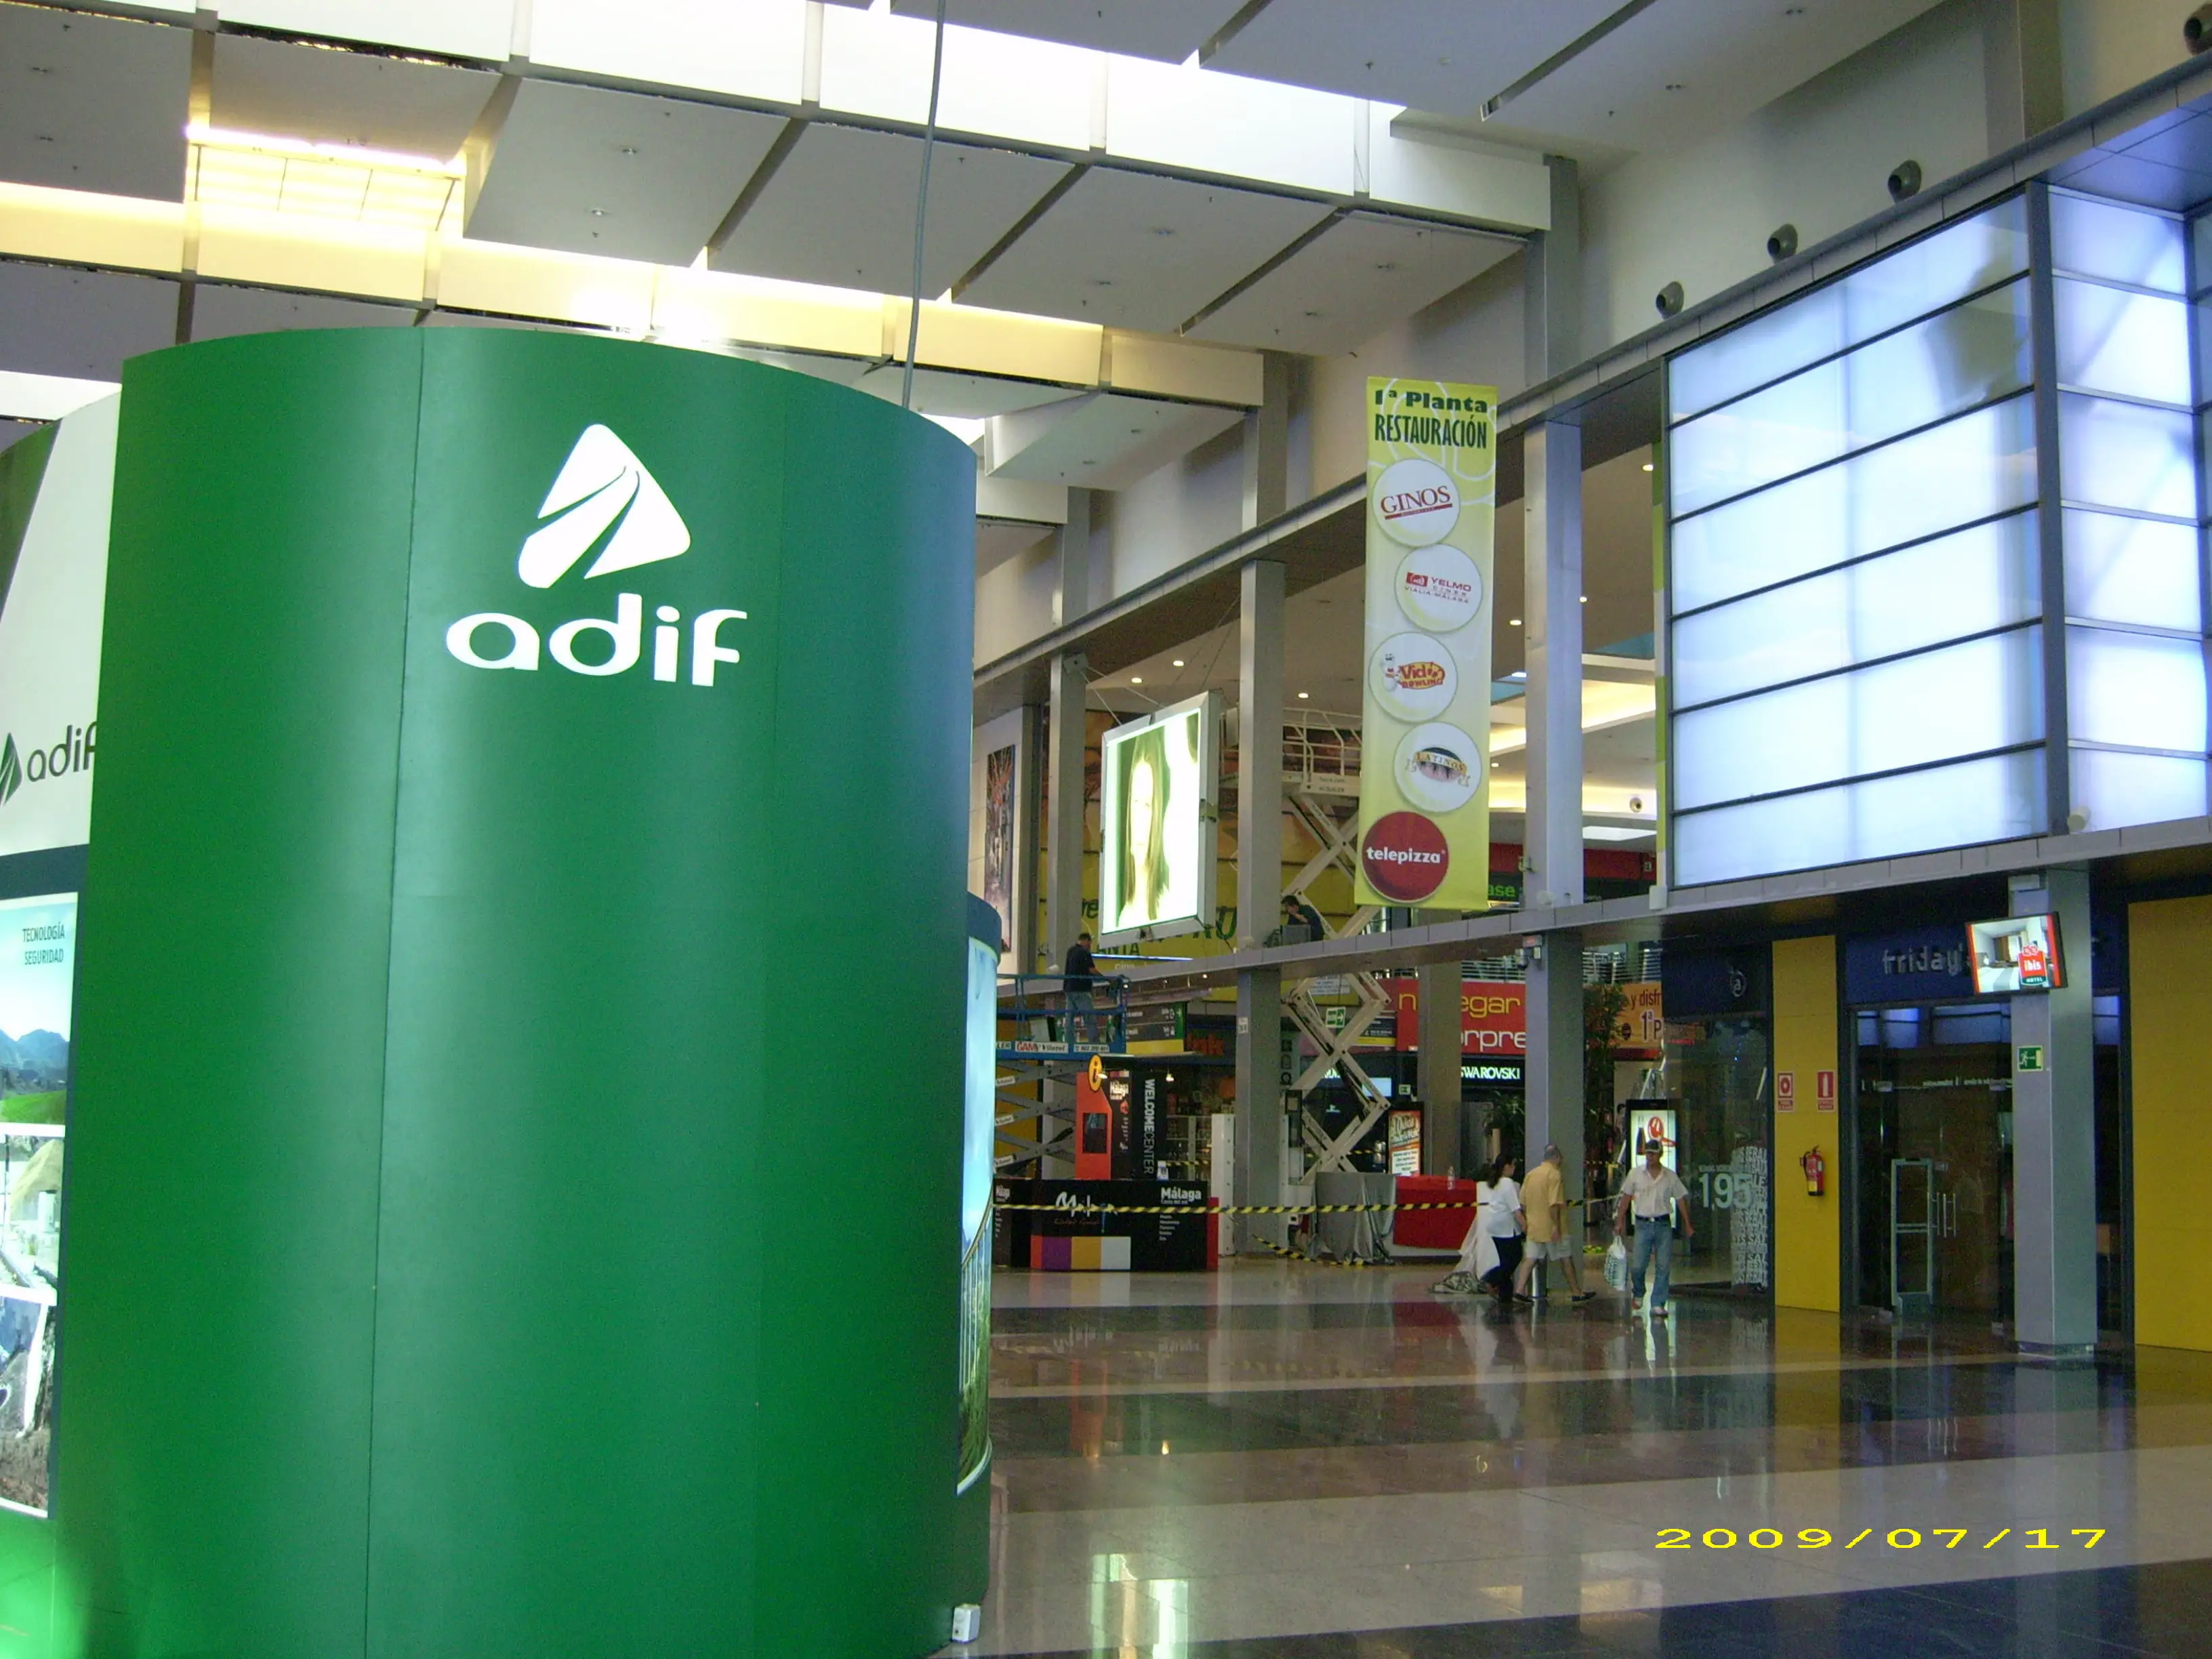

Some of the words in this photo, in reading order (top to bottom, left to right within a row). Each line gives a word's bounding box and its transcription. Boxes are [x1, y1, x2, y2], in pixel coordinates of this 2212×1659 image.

[1406, 390, 1488, 413] Planta
[1375, 414, 1487, 449] RESTAURACIÓN
[1380, 485, 1452, 514] GINOS
[1431, 577, 1472, 592] YELMO
[446, 592, 747, 687] adif
[27, 720, 97, 783] adif
[1416, 751, 1465, 771] LATINOS
[1366, 846, 1441, 865] telepizza
[22, 921, 65, 943] TECNOLOGÍA
[24, 951, 64, 966] SEGURIDAD
[2024, 959, 2043, 972] ibis
[1631, 994, 1637, 1010] y
[1460, 1029, 1526, 1052] rpre
[1460, 1066, 1521, 1080] SWAROVSKI
[1161, 1185, 1202, 1202] Málaga
